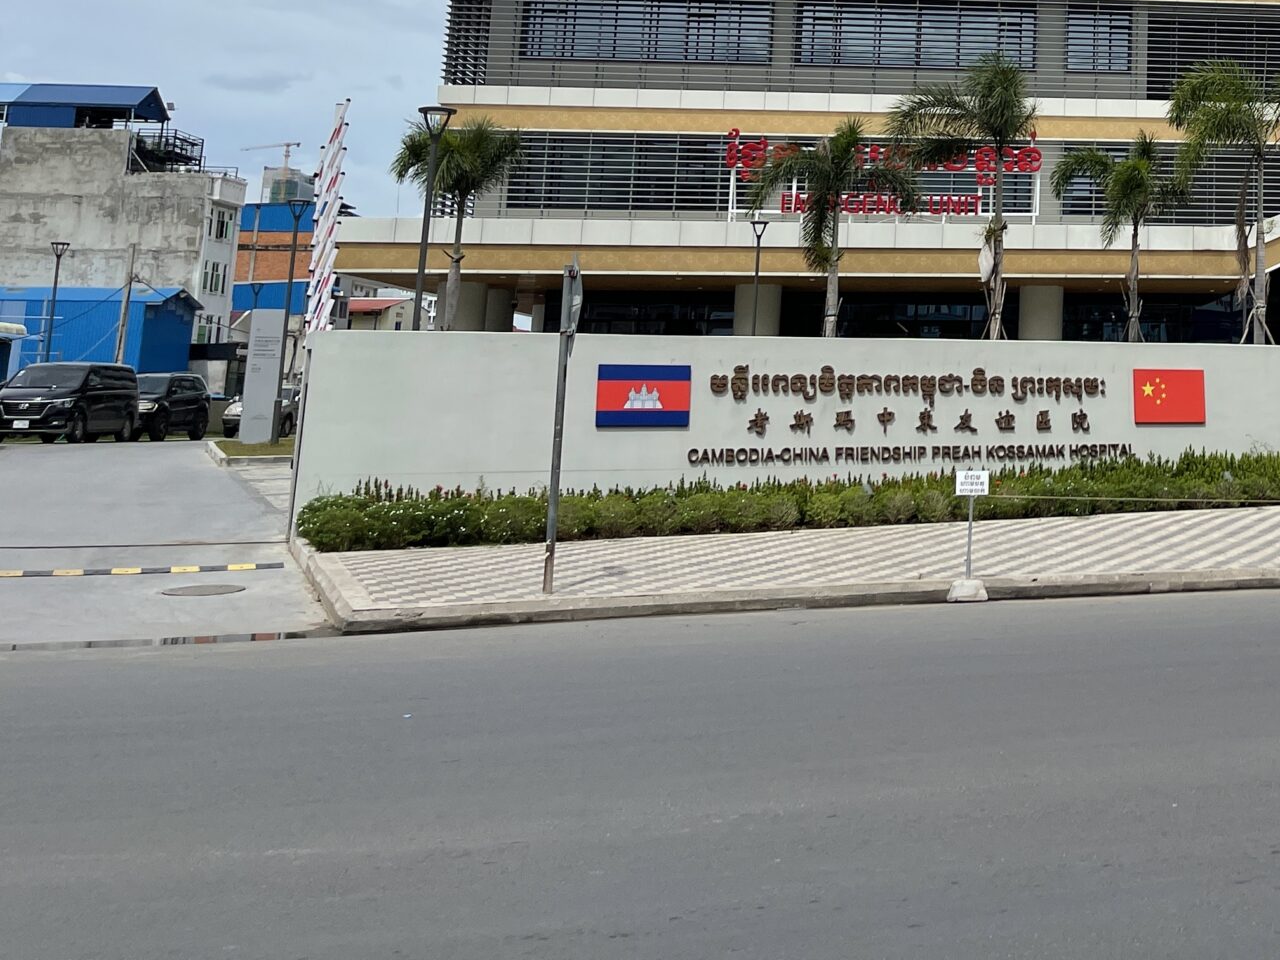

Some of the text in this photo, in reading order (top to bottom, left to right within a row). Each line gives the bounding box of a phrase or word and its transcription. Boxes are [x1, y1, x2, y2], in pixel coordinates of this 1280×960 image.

[929, 194, 983, 216] UNIT
[687, 443, 1136, 464] CAMBODIA-CHINA FRIENDSHIP PREAH KOSSAMAK HOSPITAL
